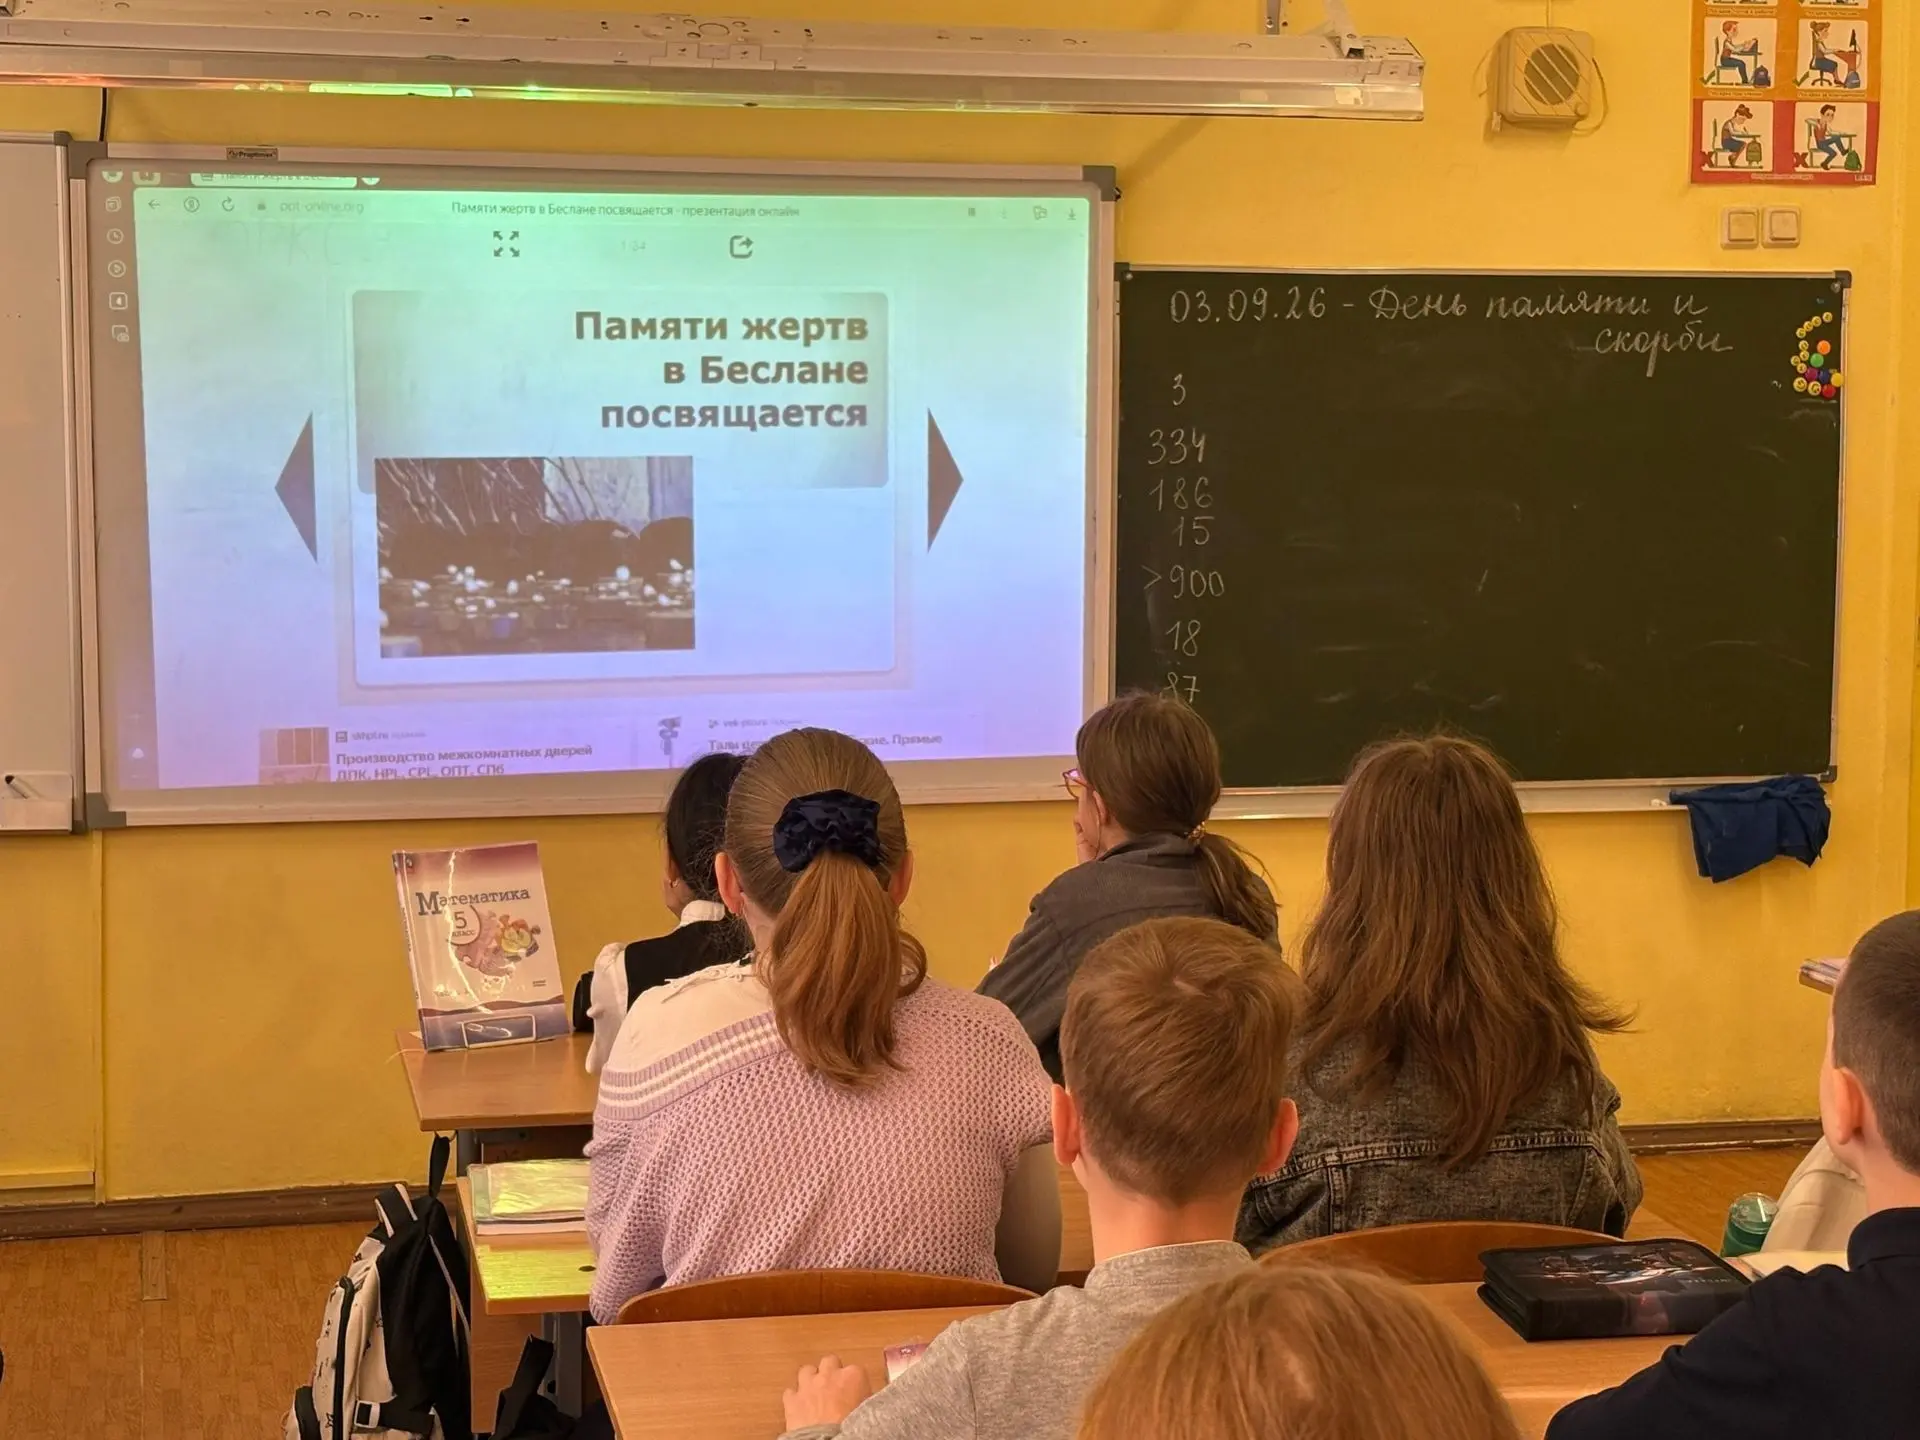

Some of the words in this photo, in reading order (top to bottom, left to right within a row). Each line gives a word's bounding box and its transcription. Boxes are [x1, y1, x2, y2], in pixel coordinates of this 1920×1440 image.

[452, 201, 497, 214] Памяти
[500, 204, 536, 215] жертв
[539, 205, 545, 214] в
[548, 203, 597, 215] Беслане
[599, 205, 673, 217] посвящается
[682, 207, 754, 218] презентация
[757, 206, 800, 217] онлайн
[1169, 286, 1327, 323] 03.09.26
[1368, 284, 1468, 321] День
[1485, 289, 1651, 319] памяти
[1673, 293, 1709, 317] и
[575, 310, 728, 341] Памяти
[742, 317, 869, 347] жертв
[1594, 319, 1734, 378] скорби
[663, 361, 686, 384] в
[700, 355, 869, 384] Беслане
[1172, 372, 1187, 406] 3
[601, 404, 868, 431] посвящается
[1147, 426, 1207, 465] 334
[1149, 476, 1214, 512] 186
[1172, 516, 1215, 547] 15
[1165, 619, 1201, 657] 18
[336, 751, 435, 767] Производство
[438, 748, 541, 761] межкомнатных
[544, 745, 593, 759] дверей
[477, 763, 505, 776] СПб
[415, 888, 531, 916] Математика
[454, 911, 468, 929] 5
